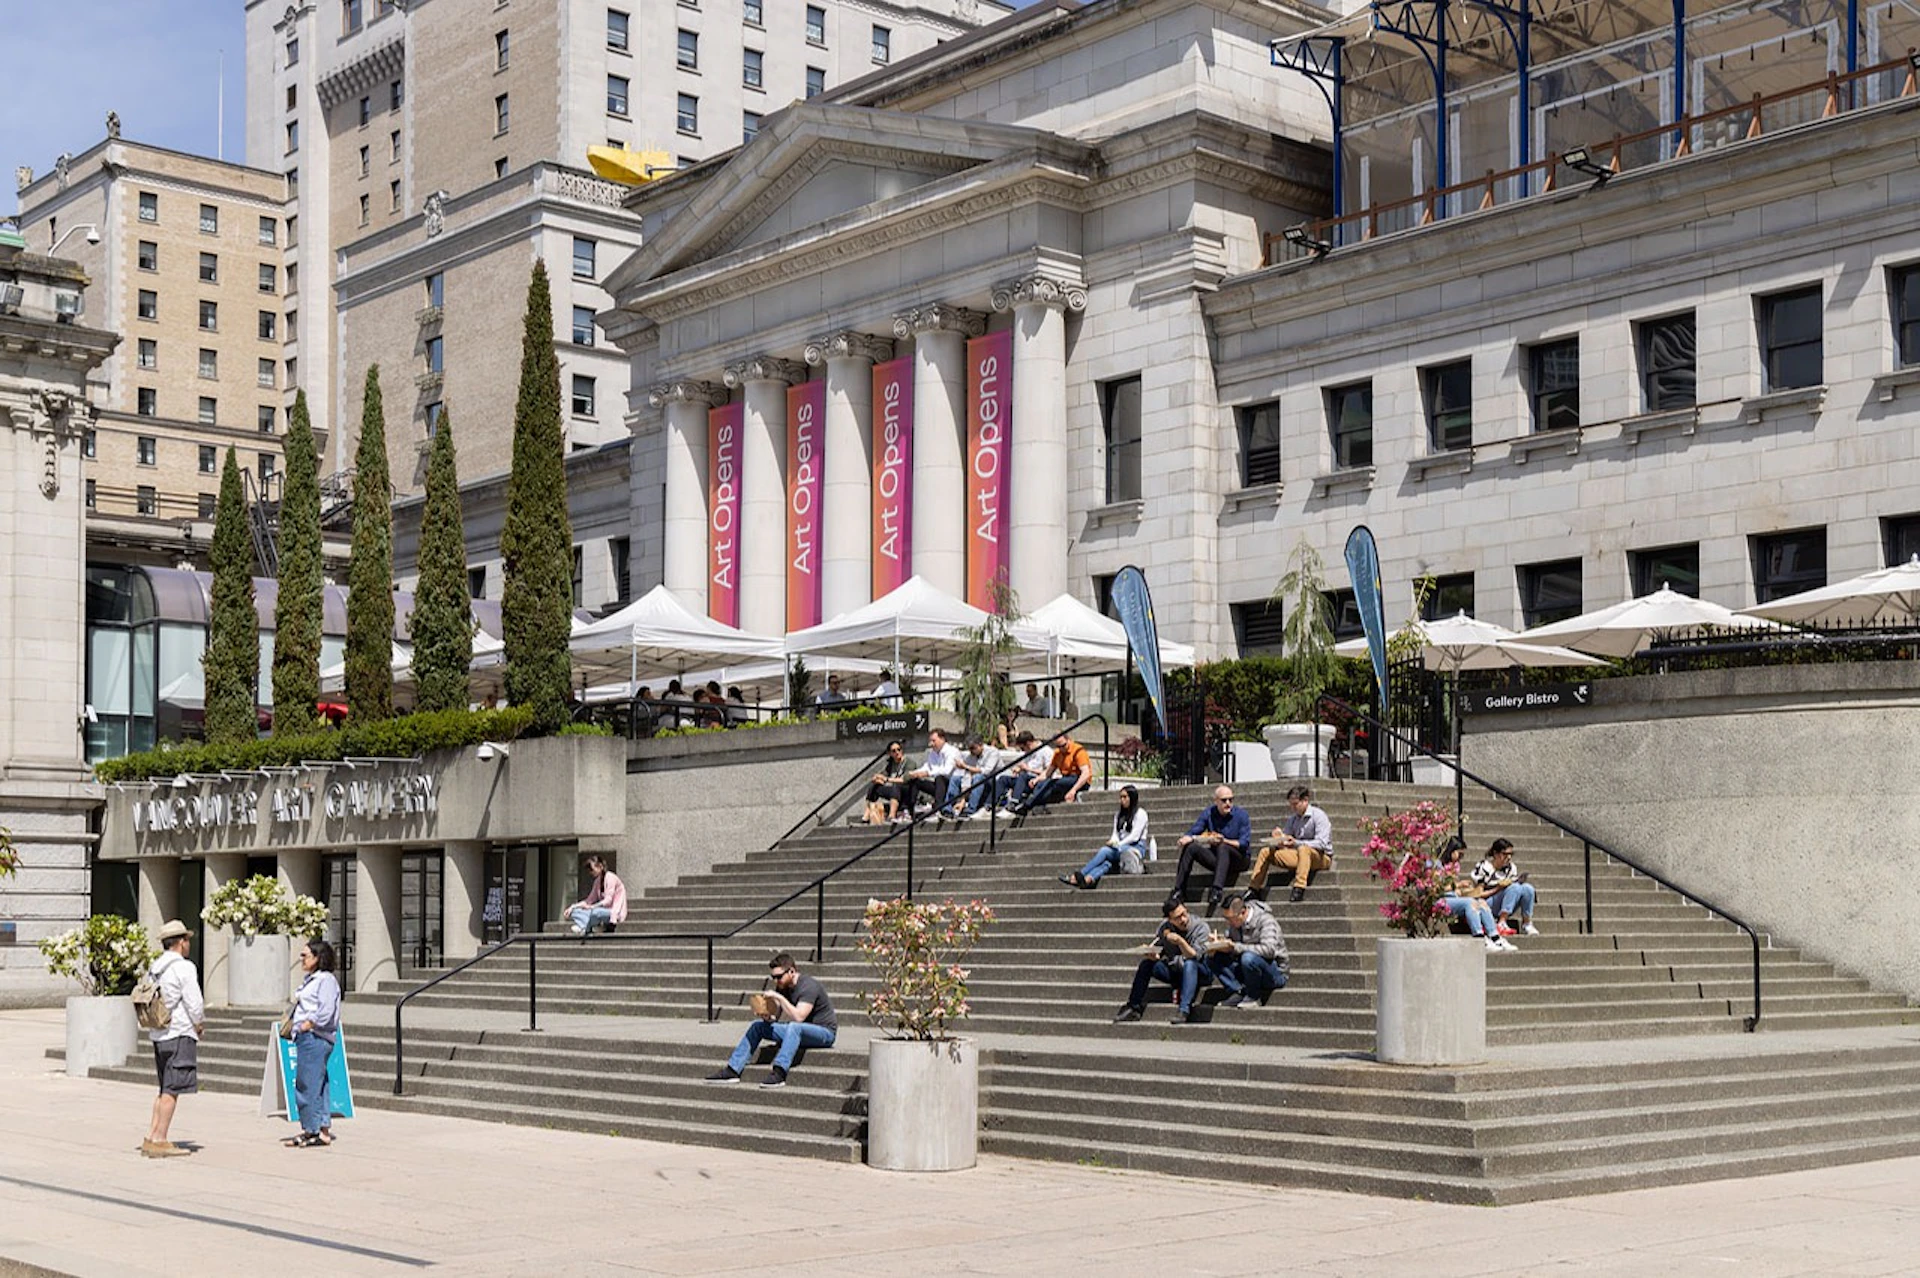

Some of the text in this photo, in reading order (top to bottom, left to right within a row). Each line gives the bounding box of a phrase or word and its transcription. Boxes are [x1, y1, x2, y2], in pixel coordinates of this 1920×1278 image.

[713, 425, 736, 589] Art Opens
[793, 403, 815, 574] Art Opens
[879, 381, 903, 560] Art Opens
[974, 356, 1003, 543] Art Opens
[856, 719, 907, 733] Gallery Bistro
[1485, 692, 1560, 708] Gallery Bistro
[272, 785, 315, 822] ART
